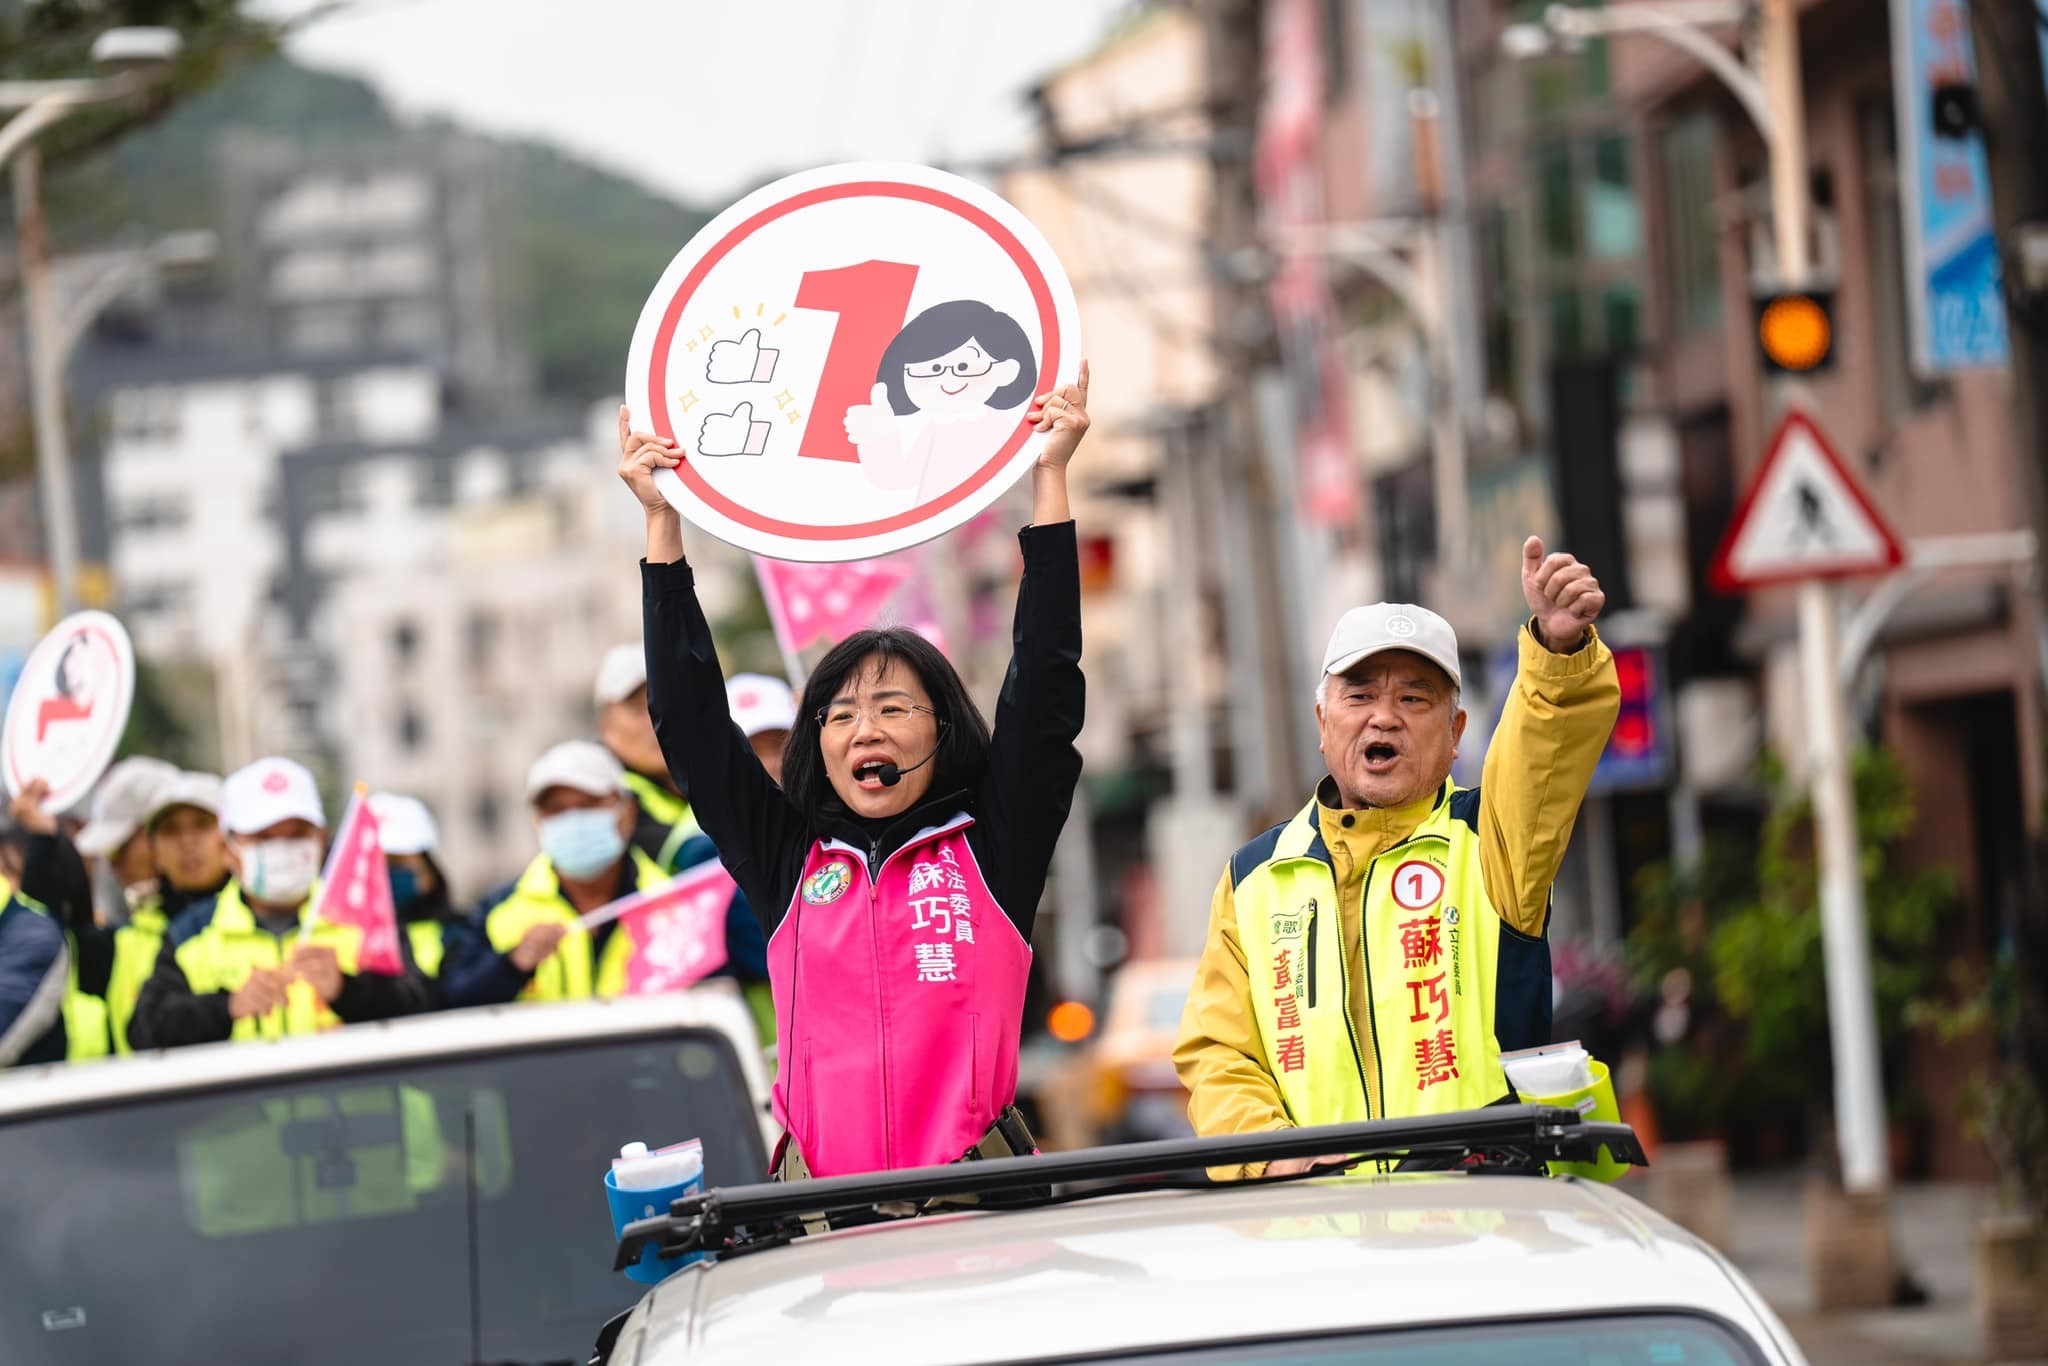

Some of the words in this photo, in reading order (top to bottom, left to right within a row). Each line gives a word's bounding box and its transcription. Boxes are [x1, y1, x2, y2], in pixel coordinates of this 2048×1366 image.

[794, 259, 920, 463] 1
[908, 861, 957, 982] 蘇巧慧
[938, 845, 975, 944] 立法委員
[1408, 873, 1423, 900] 1
[1273, 948, 1306, 1074] 黃富春
[1398, 915, 1460, 1091] 蘇巧慧
